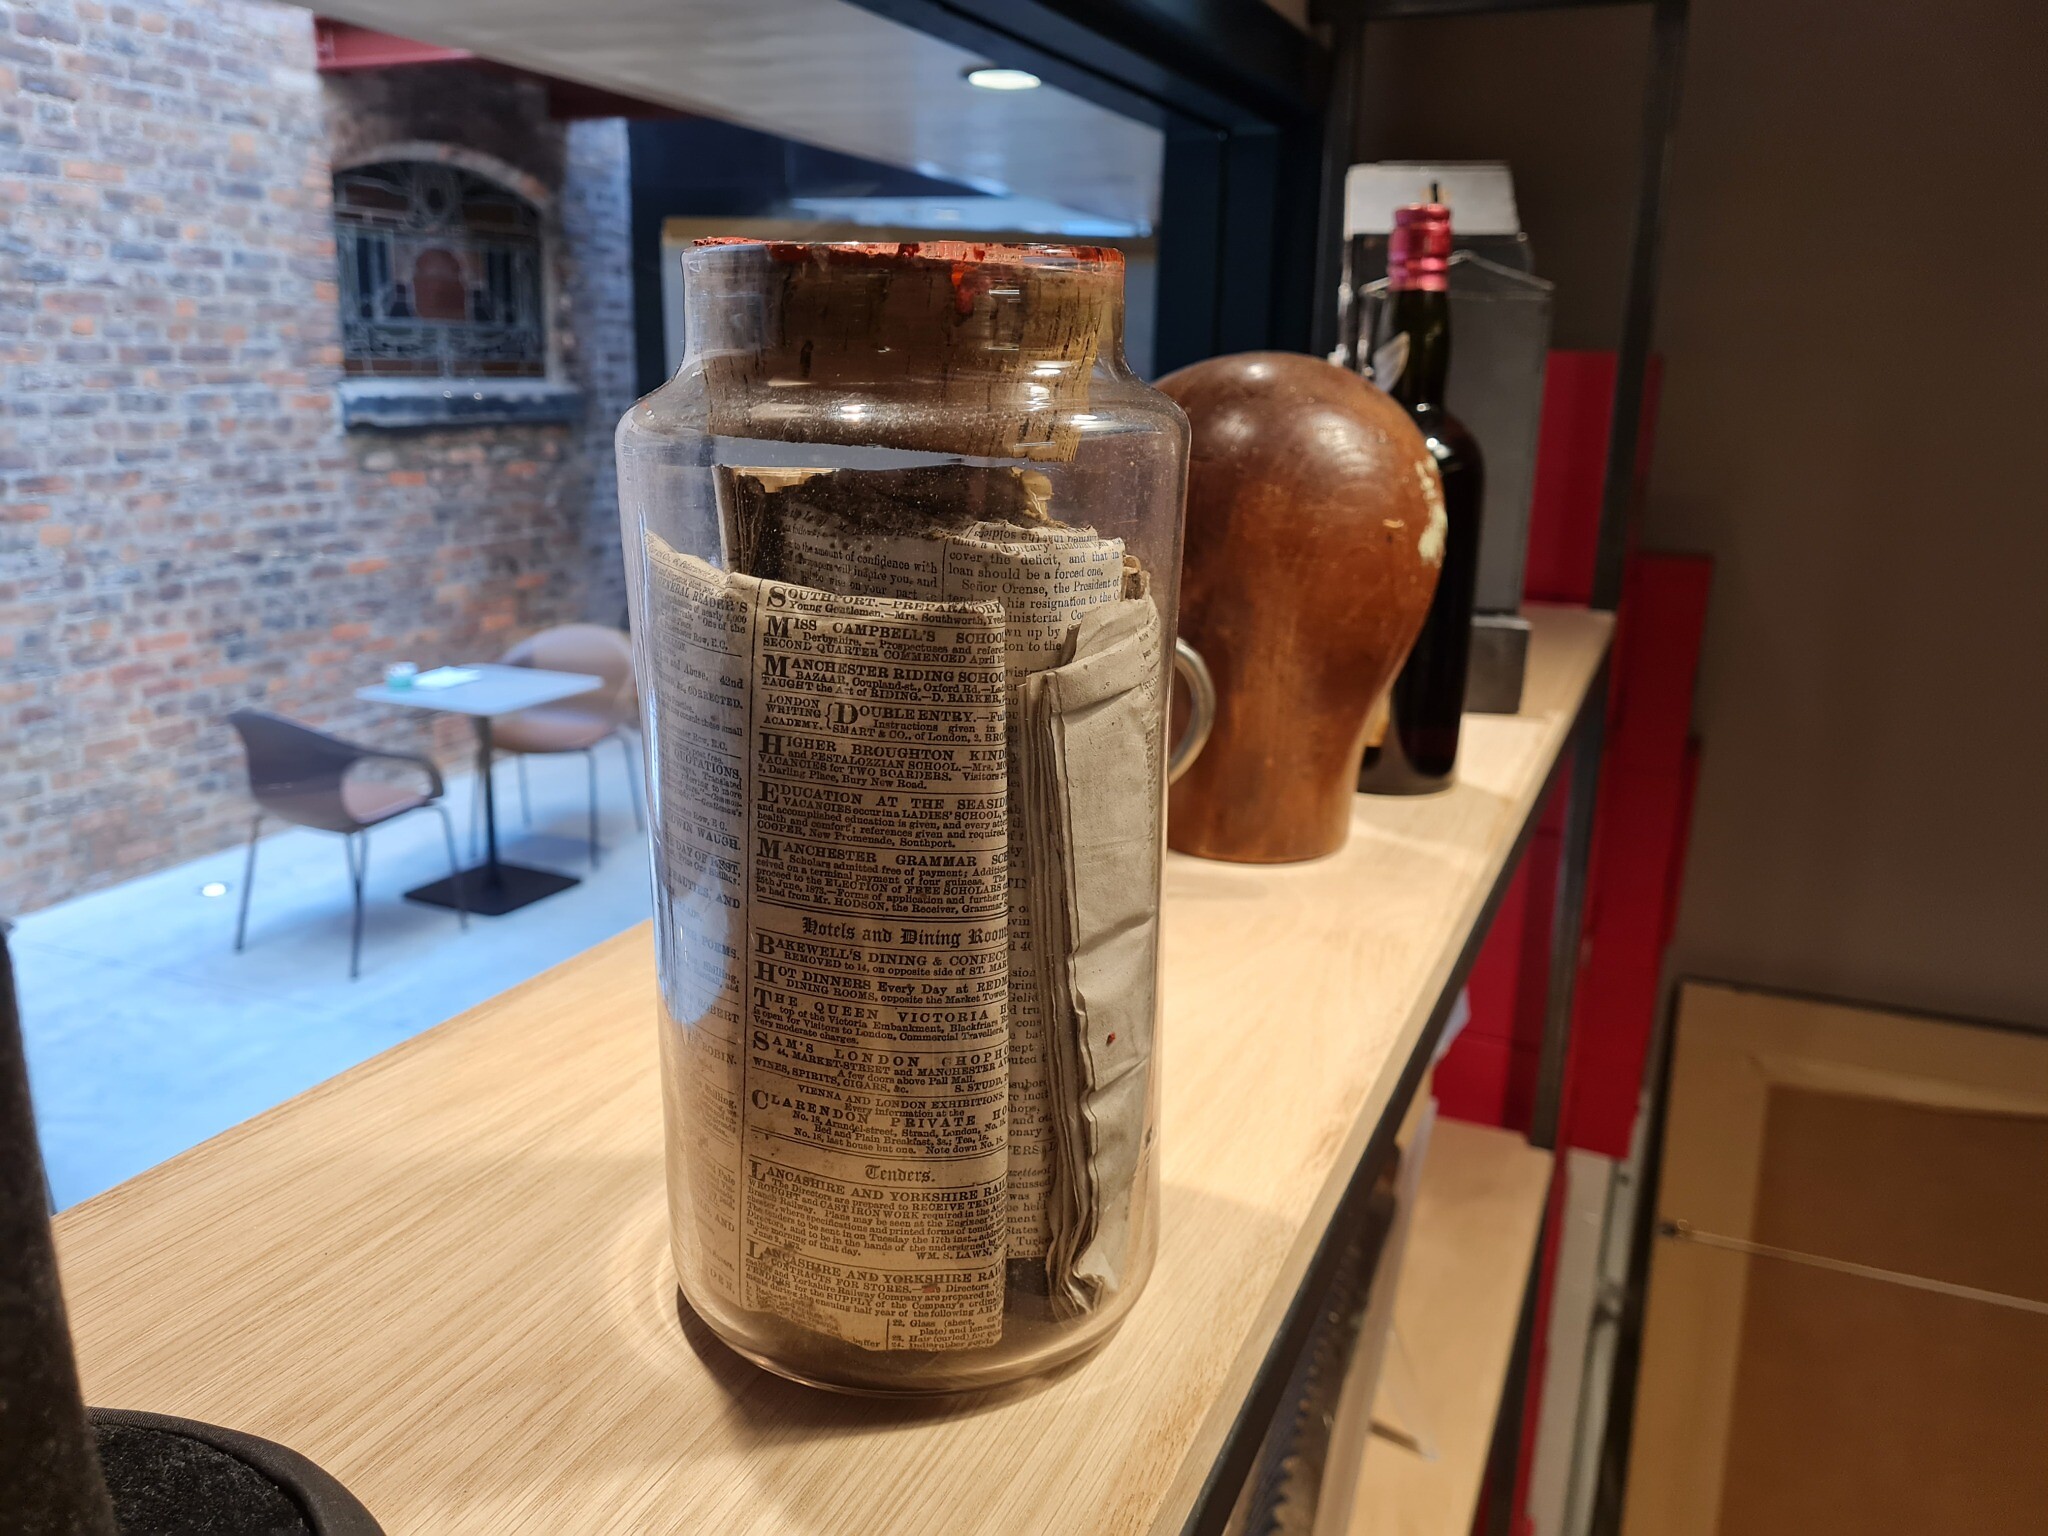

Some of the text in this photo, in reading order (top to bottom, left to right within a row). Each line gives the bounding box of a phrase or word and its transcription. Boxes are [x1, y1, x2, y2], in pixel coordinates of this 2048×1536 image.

[858, 554, 937, 574] confidence with
[950, 553, 1093, 569] cover the deficit, and
[854, 568, 886, 583] inspire
[918, 576, 937, 588] and
[950, 566, 972, 577] loan
[978, 568, 1021, 580] should
[1055, 568, 1084, 579] forced
[962, 580, 1110, 596] Señor Orense, the President
[789, 601, 821, 613] Young
[1007, 596, 1086, 608] his resignation
[1009, 611, 1062, 623] inisterial
[763, 615, 817, 638] MISS
[833, 623, 935, 642] CAMPBELL'S
[803, 632, 862, 647] Derbyshire.
[763, 637, 995, 665] SECOND QUARTER COMMENCED April
[762, 655, 888, 678] MANCHESTER
[893, 667, 954, 681] RIDING
[720, 673, 744, 688] 42nd
[762, 677, 813, 691] TAUGHT
[816, 682, 833, 693] the
[796, 671, 848, 685] BAZAAR,
[923, 683, 960, 693] Oxford
[688, 686, 743, 709] CORRECTED.
[768, 694, 819, 708] LONDON
[766, 704, 821, 719] WRITING
[834, 701, 916, 724] DOUBLE
[763, 717, 822, 730] ACADEMY.
[832, 724, 876, 737] SMART
[928, 733, 970, 743] London,
[873, 720, 975, 734] Instructions given
[759, 732, 954, 760] HIGHER BROUGHTON
[759, 753, 998, 781] VACANCIES for TWO BOARDERS. Visitors
[789, 749, 906, 769] and PESTALOZZIAN
[809, 769, 927, 790] Place, Bury New Road.
[758, 781, 944, 809] EDUCATION AT THE
[757, 811, 786, 823] health
[860, 826, 913, 838] references
[915, 829, 943, 839] given
[777, 806, 940, 831] accomplished education given,
[902, 809, 952, 821] LADIES'
[697, 828, 741, 850] WAUGH.
[757, 820, 955, 849] COOPER, New Promenade, Southport.
[757, 837, 977, 867] MANCHESTER GRAMMAR
[789, 854, 899, 875] Scholars admitted free
[756, 867, 1002, 896] proceed ELECTION FREE SCHOLARS
[810, 867, 942, 885] terminal payment four
[788, 890, 1002, 914] from Mr. HODSON, Receiver, Grammar
[887, 892, 1000, 906] application further
[802, 916, 855, 939] Hotels
[862, 927, 892, 943] and
[901, 927, 961, 948] Dining
[756, 932, 862, 961] BAKEWELL'S
[868, 952, 927, 966] DINING
[784, 951, 952, 977] REMOVED opposite side
[754, 962, 796, 984] HOT
[801, 970, 871, 990] DINNERS
[877, 981, 915, 995] Every
[922, 983, 947, 995] Day
[956, 984, 969, 993] at
[786, 979, 829, 994] DINING
[833, 987, 878, 1002] ROOMS,
[946, 994, 981, 1004] Market
[753, 987, 988, 1023] THE QUEEN VICTORIA
[828, 1015, 998, 1033] Victoria Embankment, Blackfriars
[753, 1031, 920, 1066] SAM'S LONDON
[820, 1031, 859, 1045] charges.
[753, 1057, 891, 1092] WINES, SPIRITS, CIGARS,
[793, 1052, 996, 1077] MARKET-STREET MANCHESTER
[866, 1074, 975, 1085] doors above Pall Mall.
[798, 1085, 1004, 1109] VIENNA LONDON EXHIBITIONS.
[752, 1090, 976, 1129] CLARENDON PRIVATE
[749, 1159, 978, 1202] LANCASHIRE AND YORKSHIRE
[865, 1164, 935, 1182] Tenders.
[847, 1270, 879, 1282] AND
[883, 1274, 972, 1284] YORKSHIRE
